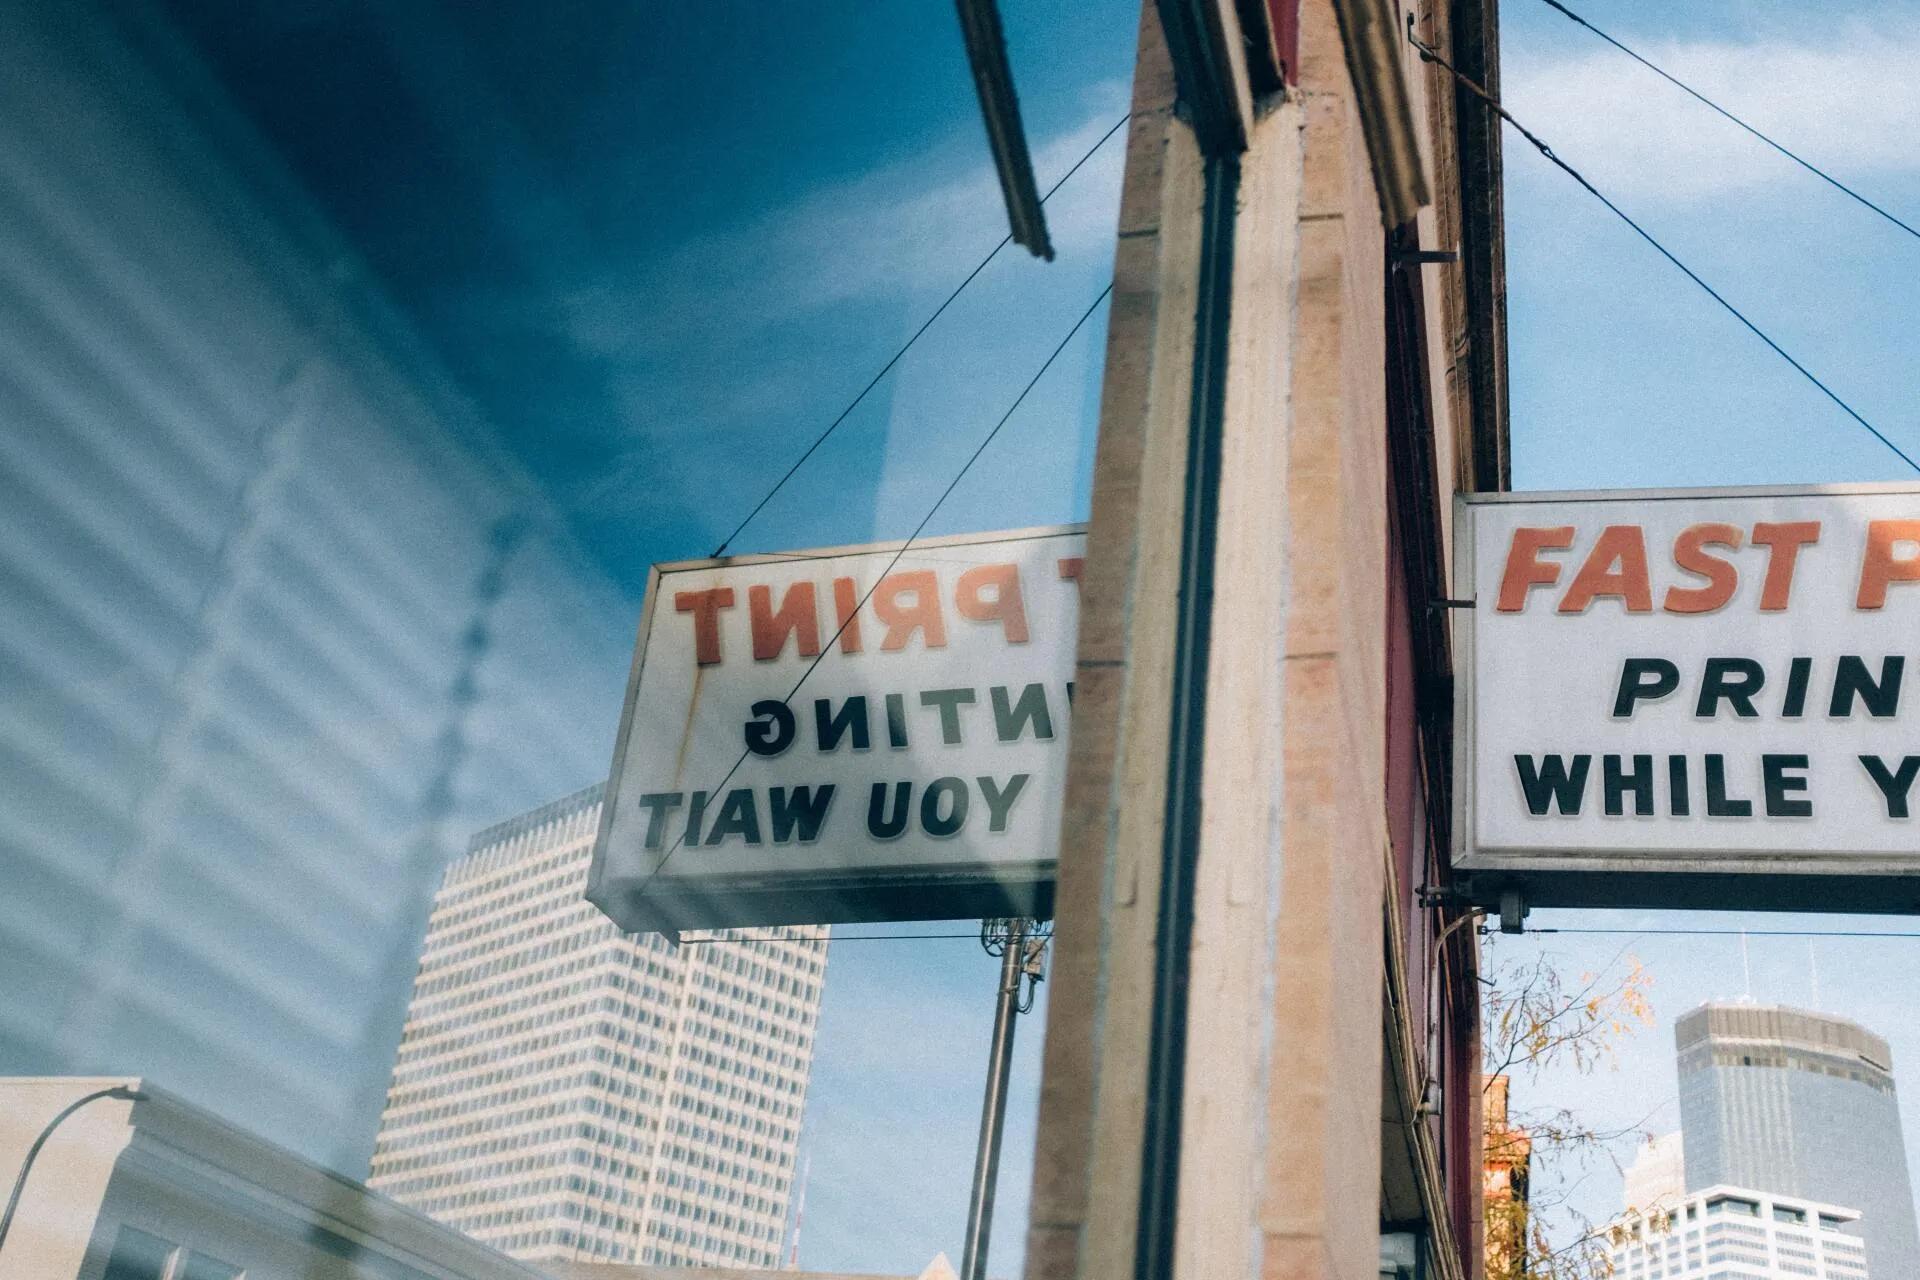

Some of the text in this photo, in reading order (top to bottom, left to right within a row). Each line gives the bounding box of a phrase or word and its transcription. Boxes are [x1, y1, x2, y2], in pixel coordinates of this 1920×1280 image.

[1496, 520, 1920, 613] FAST P
[1613, 655, 1905, 717] PRIN
[1514, 754, 1920, 818] WHILE Y
